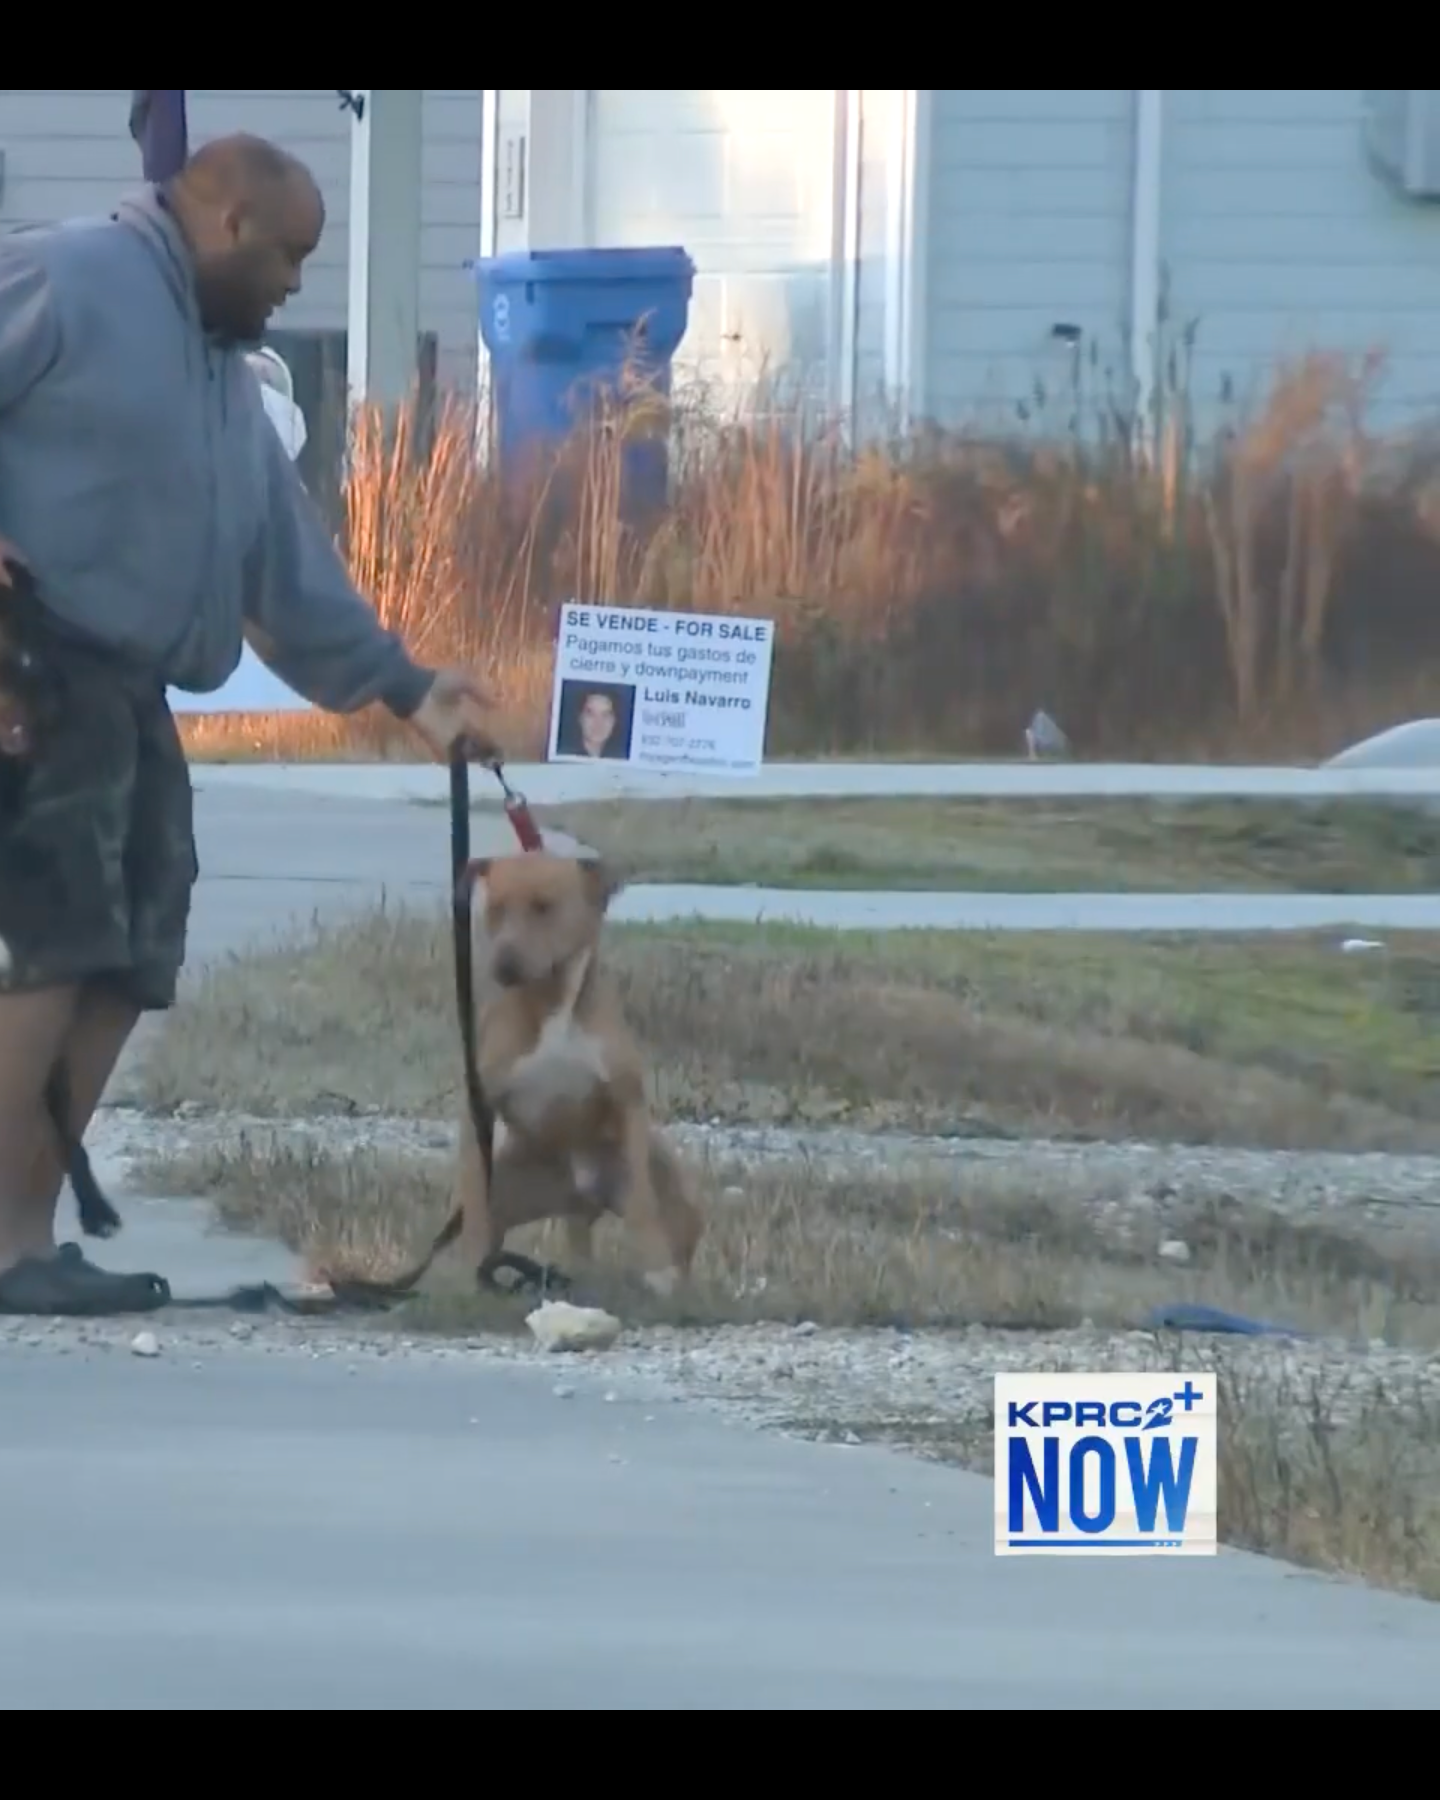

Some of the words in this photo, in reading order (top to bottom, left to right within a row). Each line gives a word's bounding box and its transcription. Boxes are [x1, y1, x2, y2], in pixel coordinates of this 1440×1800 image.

[567, 611, 590, 627] SE
[597, 613, 658, 632] VENDE
[675, 620, 713, 636] FOR
[719, 624, 767, 641] SALE
[566, 634, 642, 654] Pagamos
[648, 642, 672, 658] tus
[677, 647, 730, 663] gastos
[736, 649, 757, 665] de
[570, 657, 616, 672] cierre
[621, 663, 630, 678] y
[635, 661, 748, 684] downpayment
[644, 687, 680, 704] Luis
[684, 690, 751, 709] Navarro
